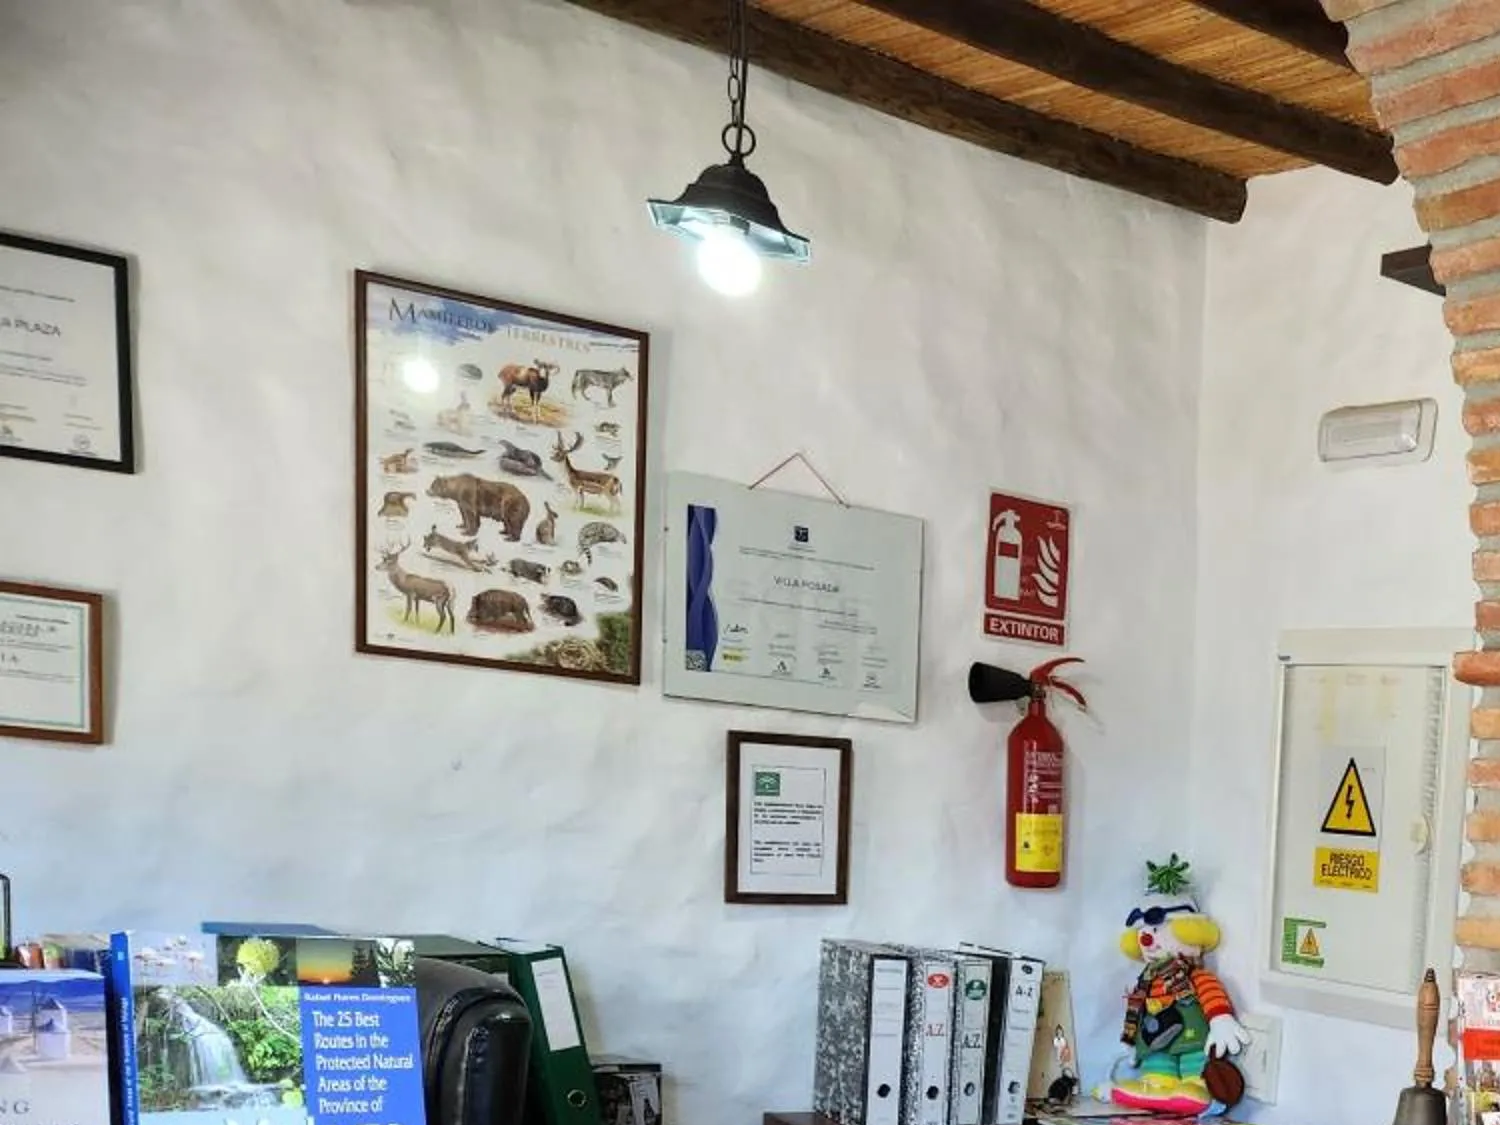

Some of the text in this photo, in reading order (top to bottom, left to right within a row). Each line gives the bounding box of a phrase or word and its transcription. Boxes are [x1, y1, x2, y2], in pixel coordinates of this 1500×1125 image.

[989, 617, 1060, 641] EXTINTOR
[1330, 852, 1365, 867] RIESGO
[312, 1010, 380, 1027] The 25 Best
[314, 1032, 389, 1049] Routes in the
[315, 1053, 413, 1071] Protected Natural
[317, 1075, 388, 1093] Areas of the
[319, 1096, 384, 1115] Province of
